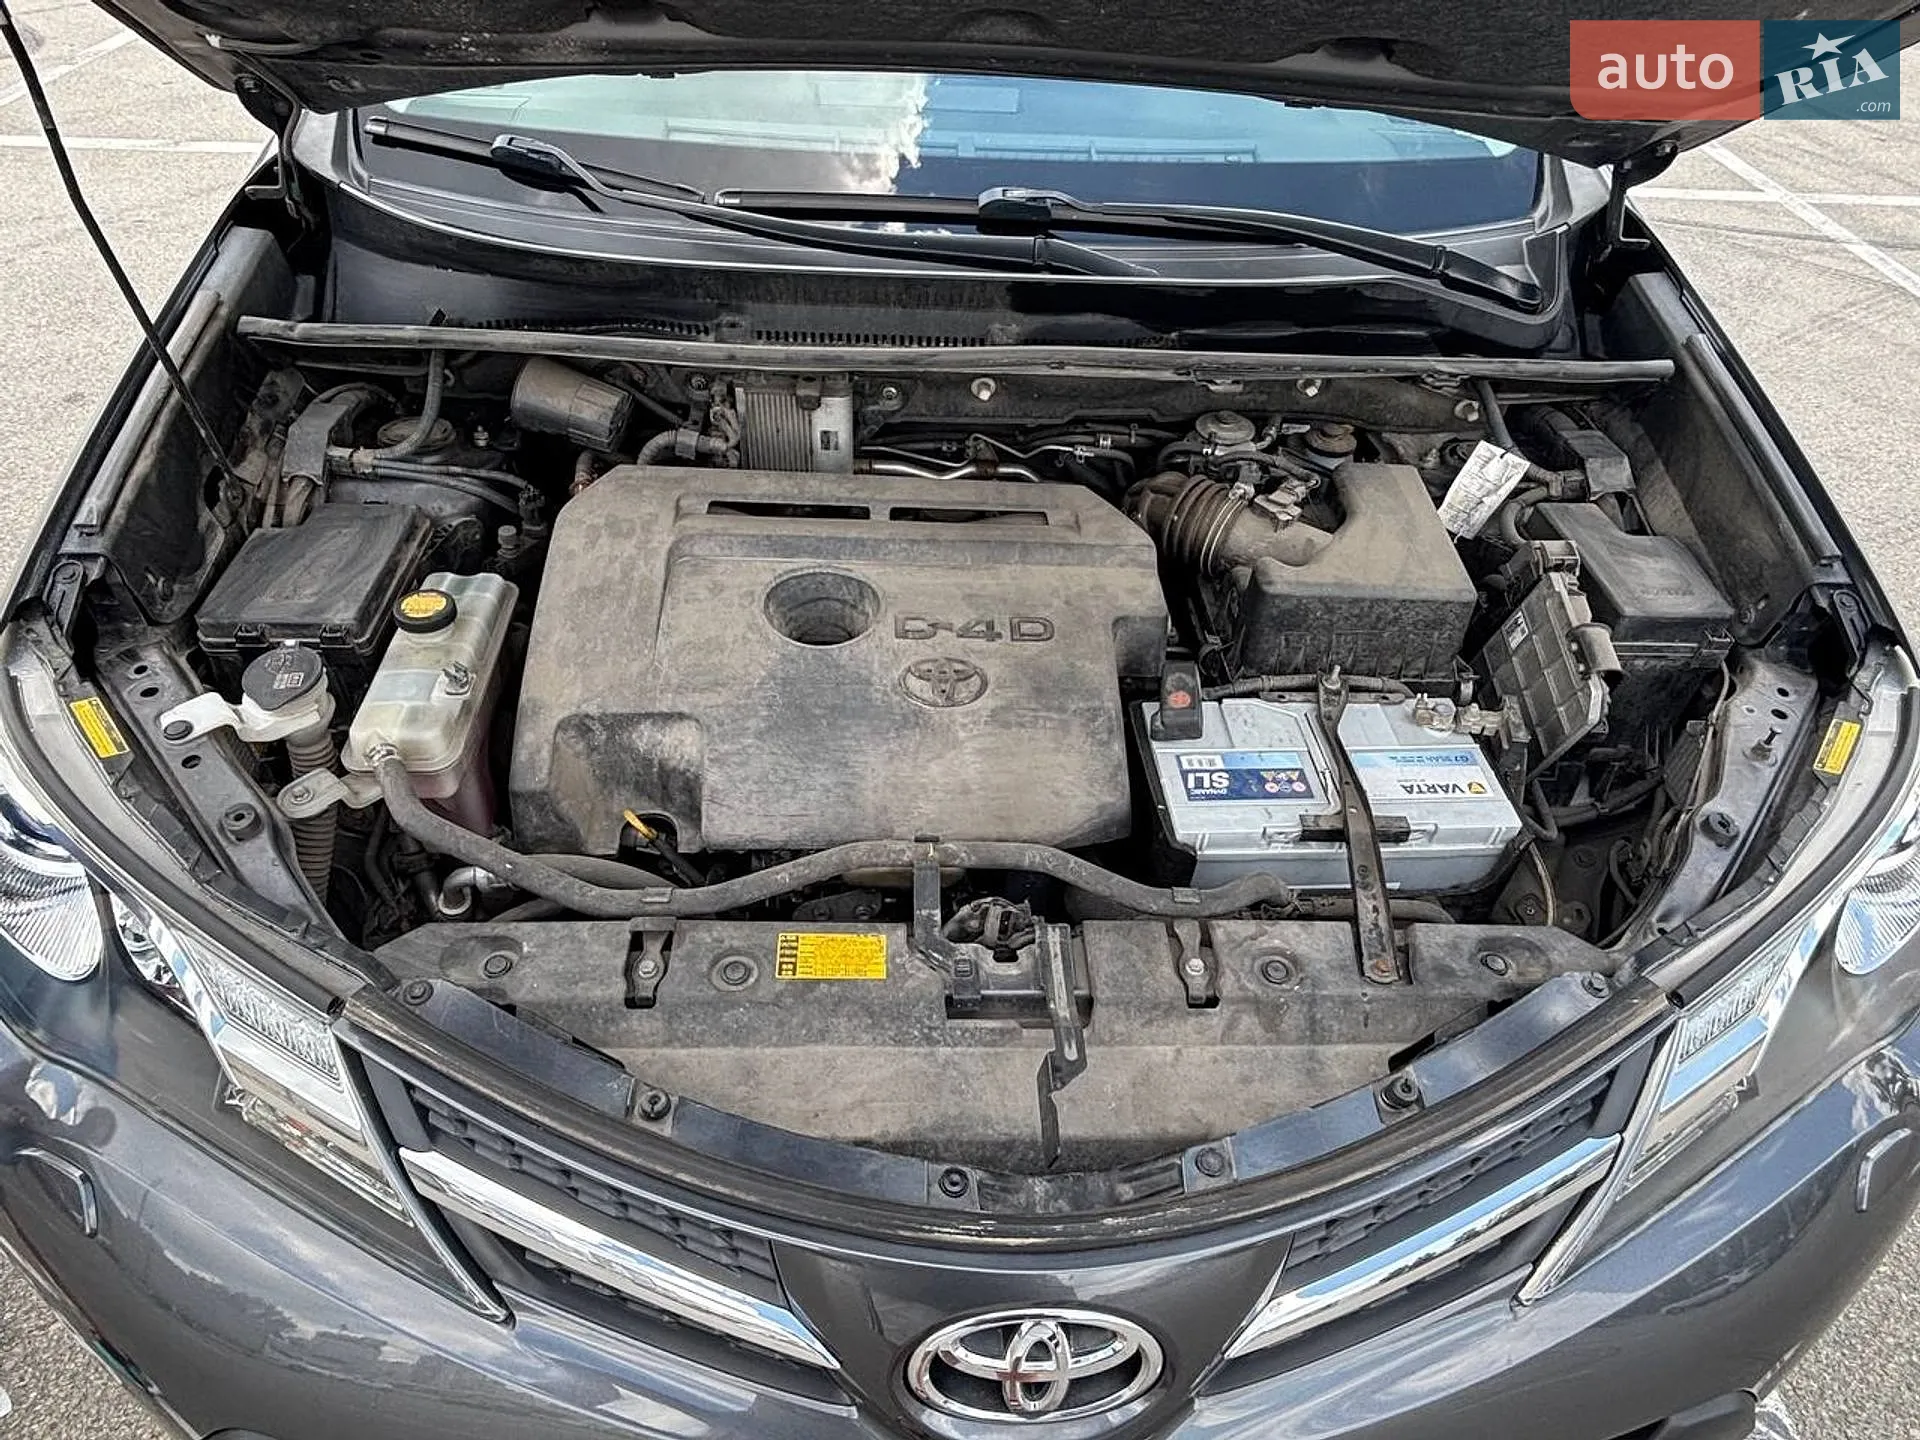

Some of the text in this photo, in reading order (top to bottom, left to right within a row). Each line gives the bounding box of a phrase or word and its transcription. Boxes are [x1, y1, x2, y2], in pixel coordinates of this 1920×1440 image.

[894, 613, 1055, 642] D-4D
[1187, 771, 1230, 789] SLI
[1400, 783, 1466, 795] VARTA
